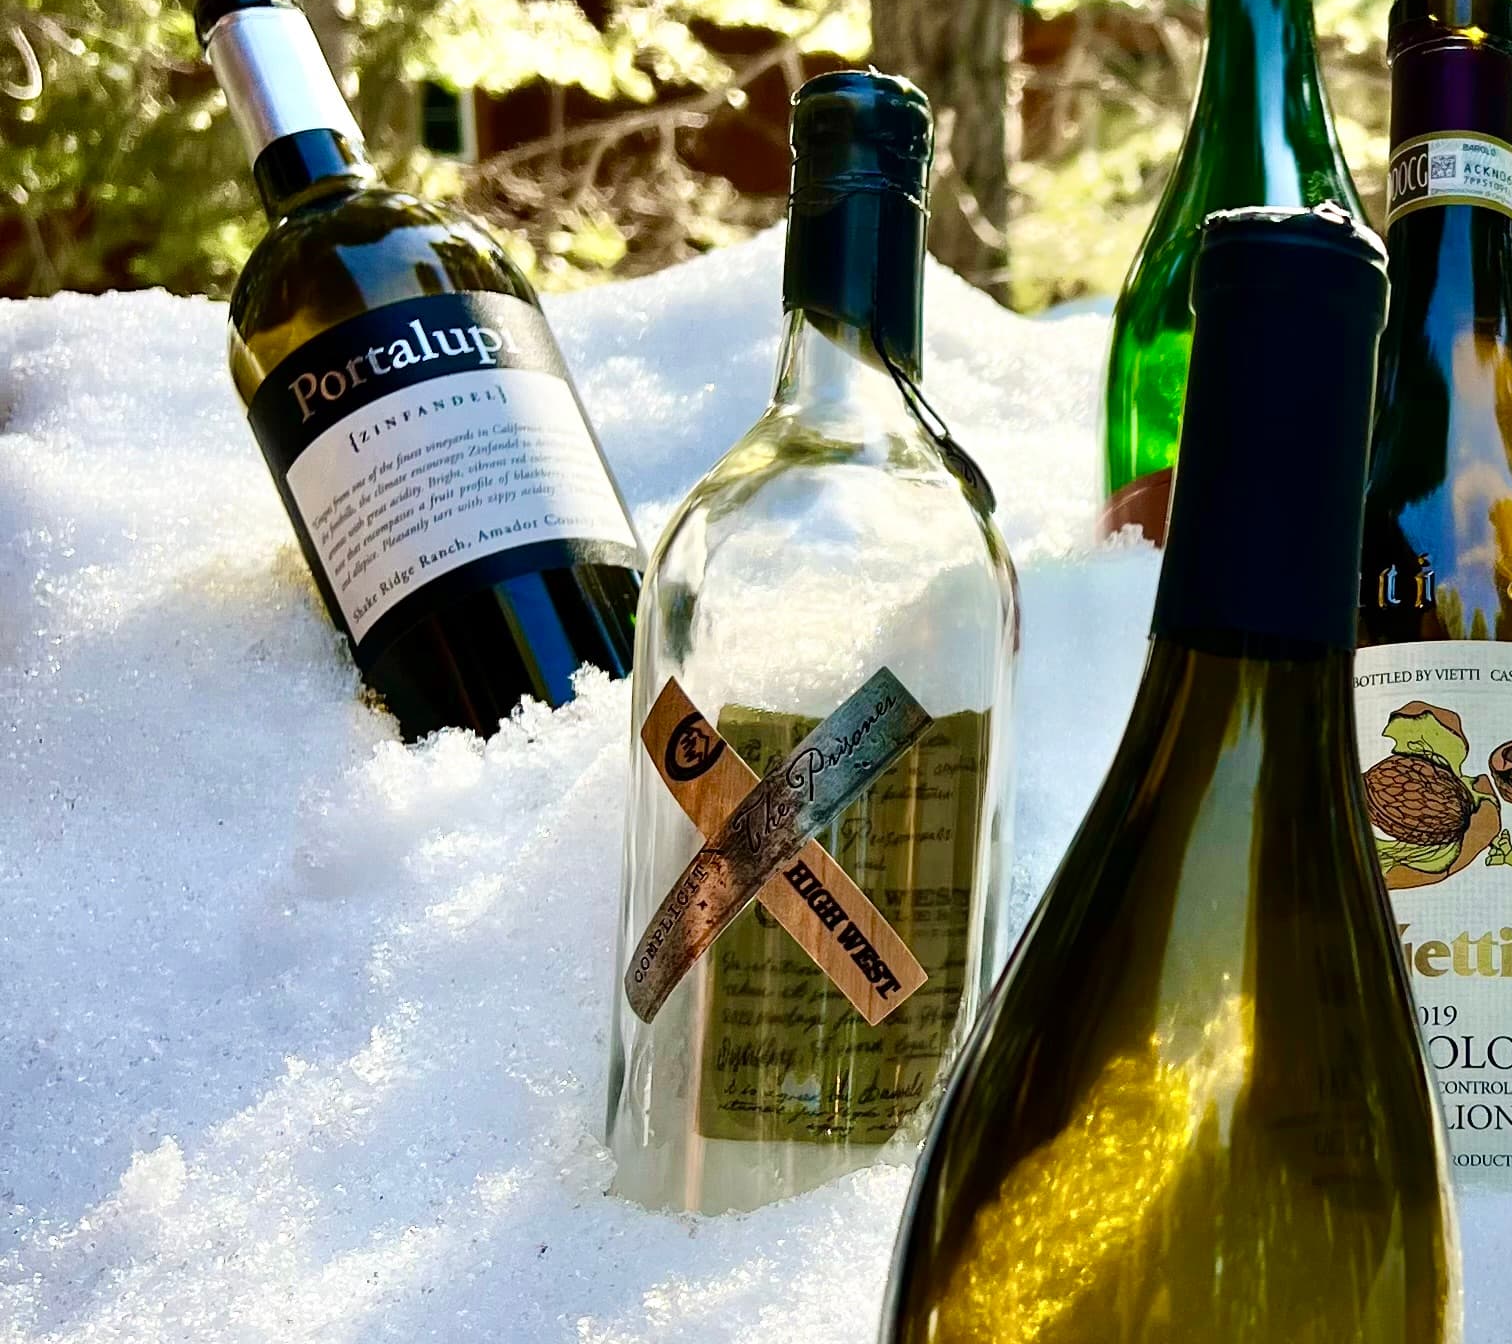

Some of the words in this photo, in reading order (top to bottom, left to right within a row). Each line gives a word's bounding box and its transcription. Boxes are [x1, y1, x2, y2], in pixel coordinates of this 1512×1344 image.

[288, 317, 517, 424] Portalupi
[425, 429, 475, 455] vineyards
[477, 427, 489, 439] in
[468, 438, 519, 458] Zinfandel
[460, 475, 494, 498] profile
[498, 467, 510, 484] of
[382, 516, 430, 553] Pleasantly
[457, 495, 483, 513] with
[487, 487, 517, 506] zippy
[379, 564, 416, 597] Ridge
[418, 537, 473, 568] Ranch,
[477, 518, 539, 543] Amador
[1352, 670, 1413, 689] BOTTLED
[1415, 668, 1433, 682] BY
[1434, 667, 1481, 681] VIETTI
[732, 784, 790, 855] The
[781, 859, 841, 934] HIGH
[836, 919, 902, 1000] WEST
